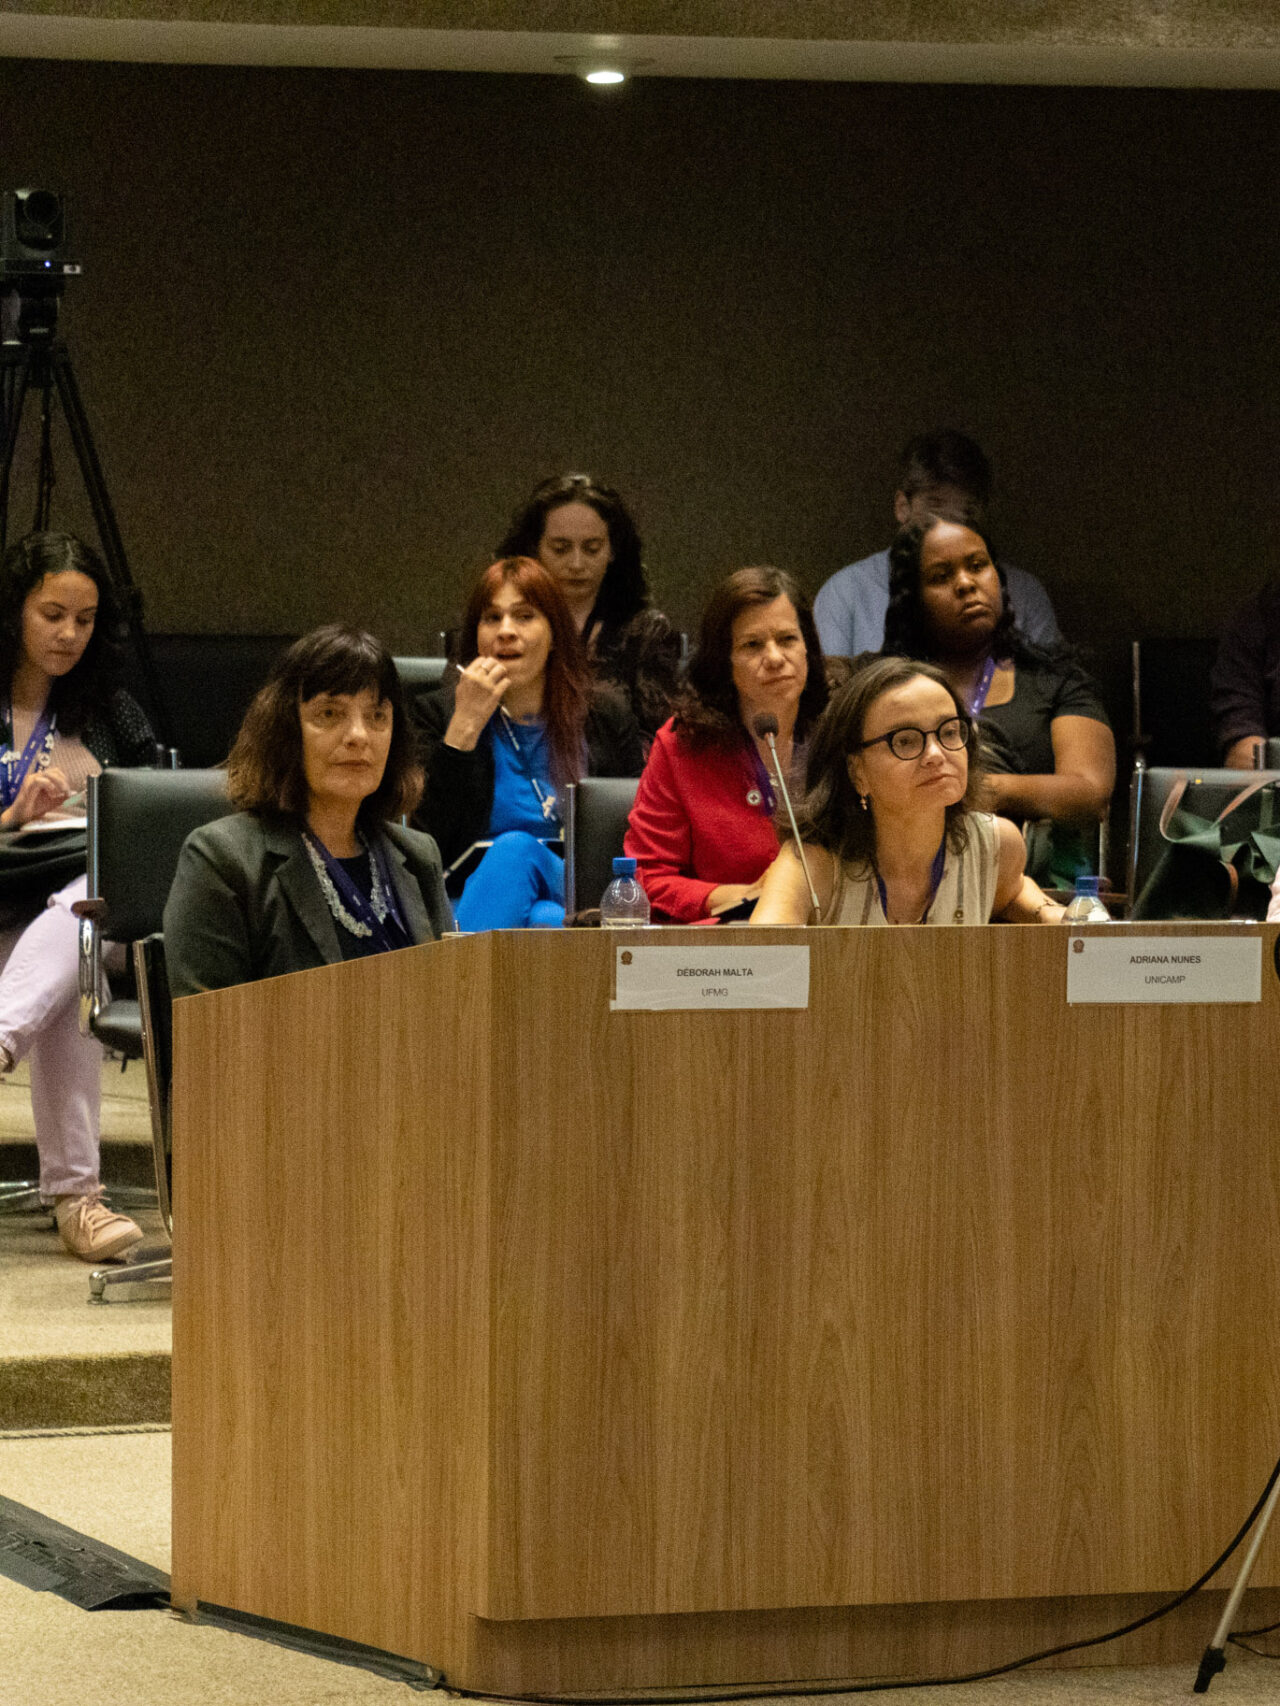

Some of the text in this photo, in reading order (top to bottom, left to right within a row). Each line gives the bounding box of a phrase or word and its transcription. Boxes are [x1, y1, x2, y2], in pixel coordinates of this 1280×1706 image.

[1129, 955, 1201, 964] ADRIANA NUNES
[722, 968, 753, 977] MALTA
[1144, 975, 1186, 984] UNICAMP
[701, 988, 729, 997] UFMG
